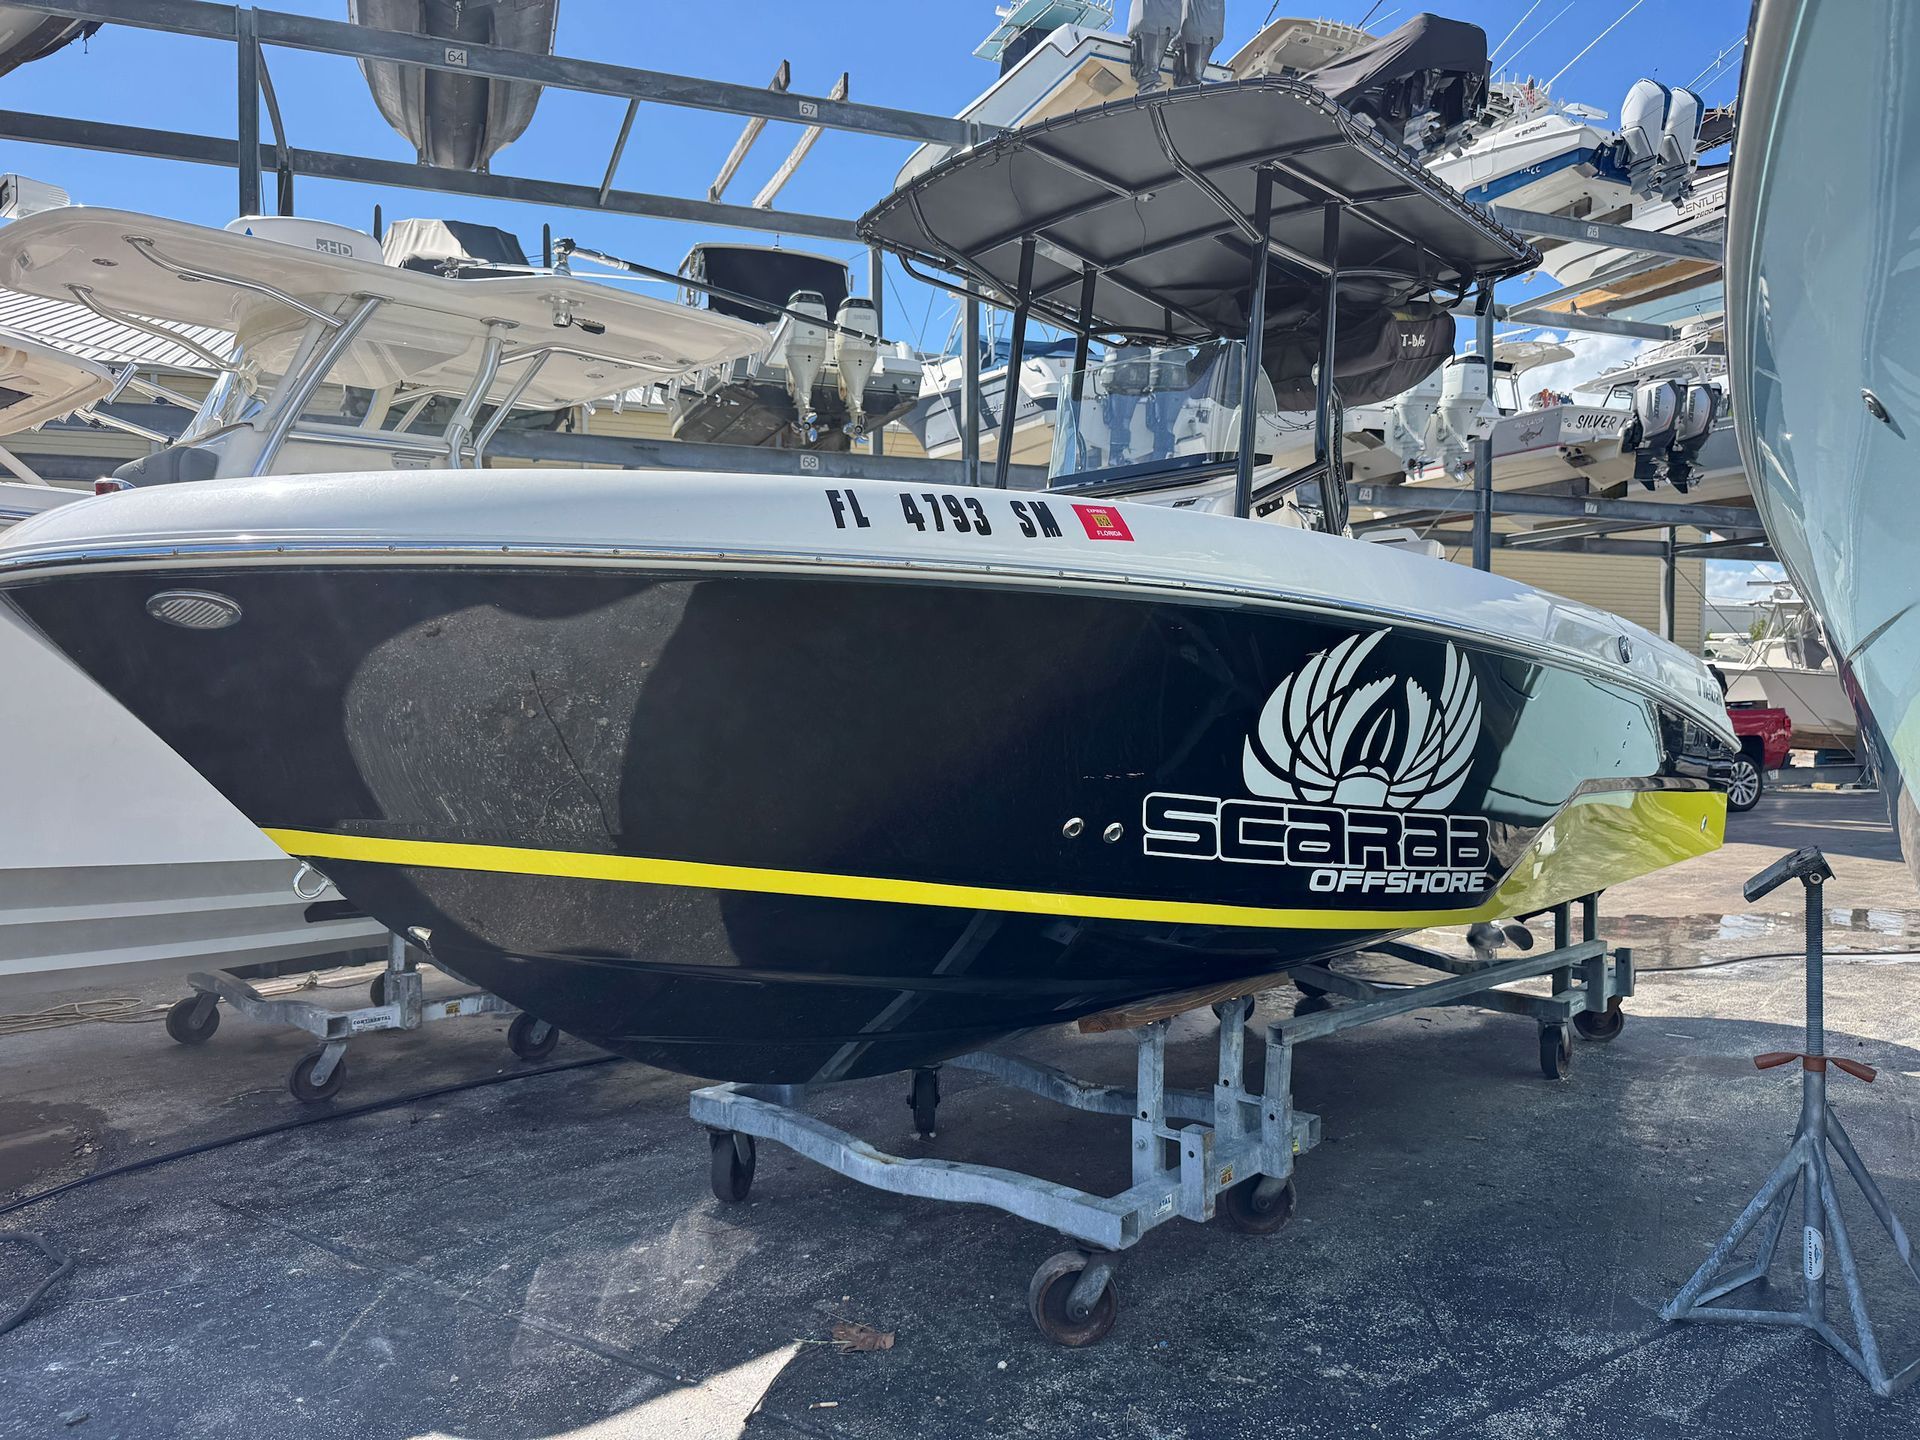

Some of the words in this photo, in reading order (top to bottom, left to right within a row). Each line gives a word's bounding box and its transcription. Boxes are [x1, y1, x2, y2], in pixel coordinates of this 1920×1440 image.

[448, 50, 464, 63] 64
[801, 103, 815, 115] 67
[1588, 226, 1598, 237] 76
[1575, 414, 1614, 430] SILVER
[803, 456, 817, 468] 68
[1360, 488, 1371, 499] 74
[825, 489, 871, 528] FL
[899, 493, 992, 536] 4793
[1009, 500, 1063, 538] SM
[1309, 869, 1488, 893] OFFSHORE
